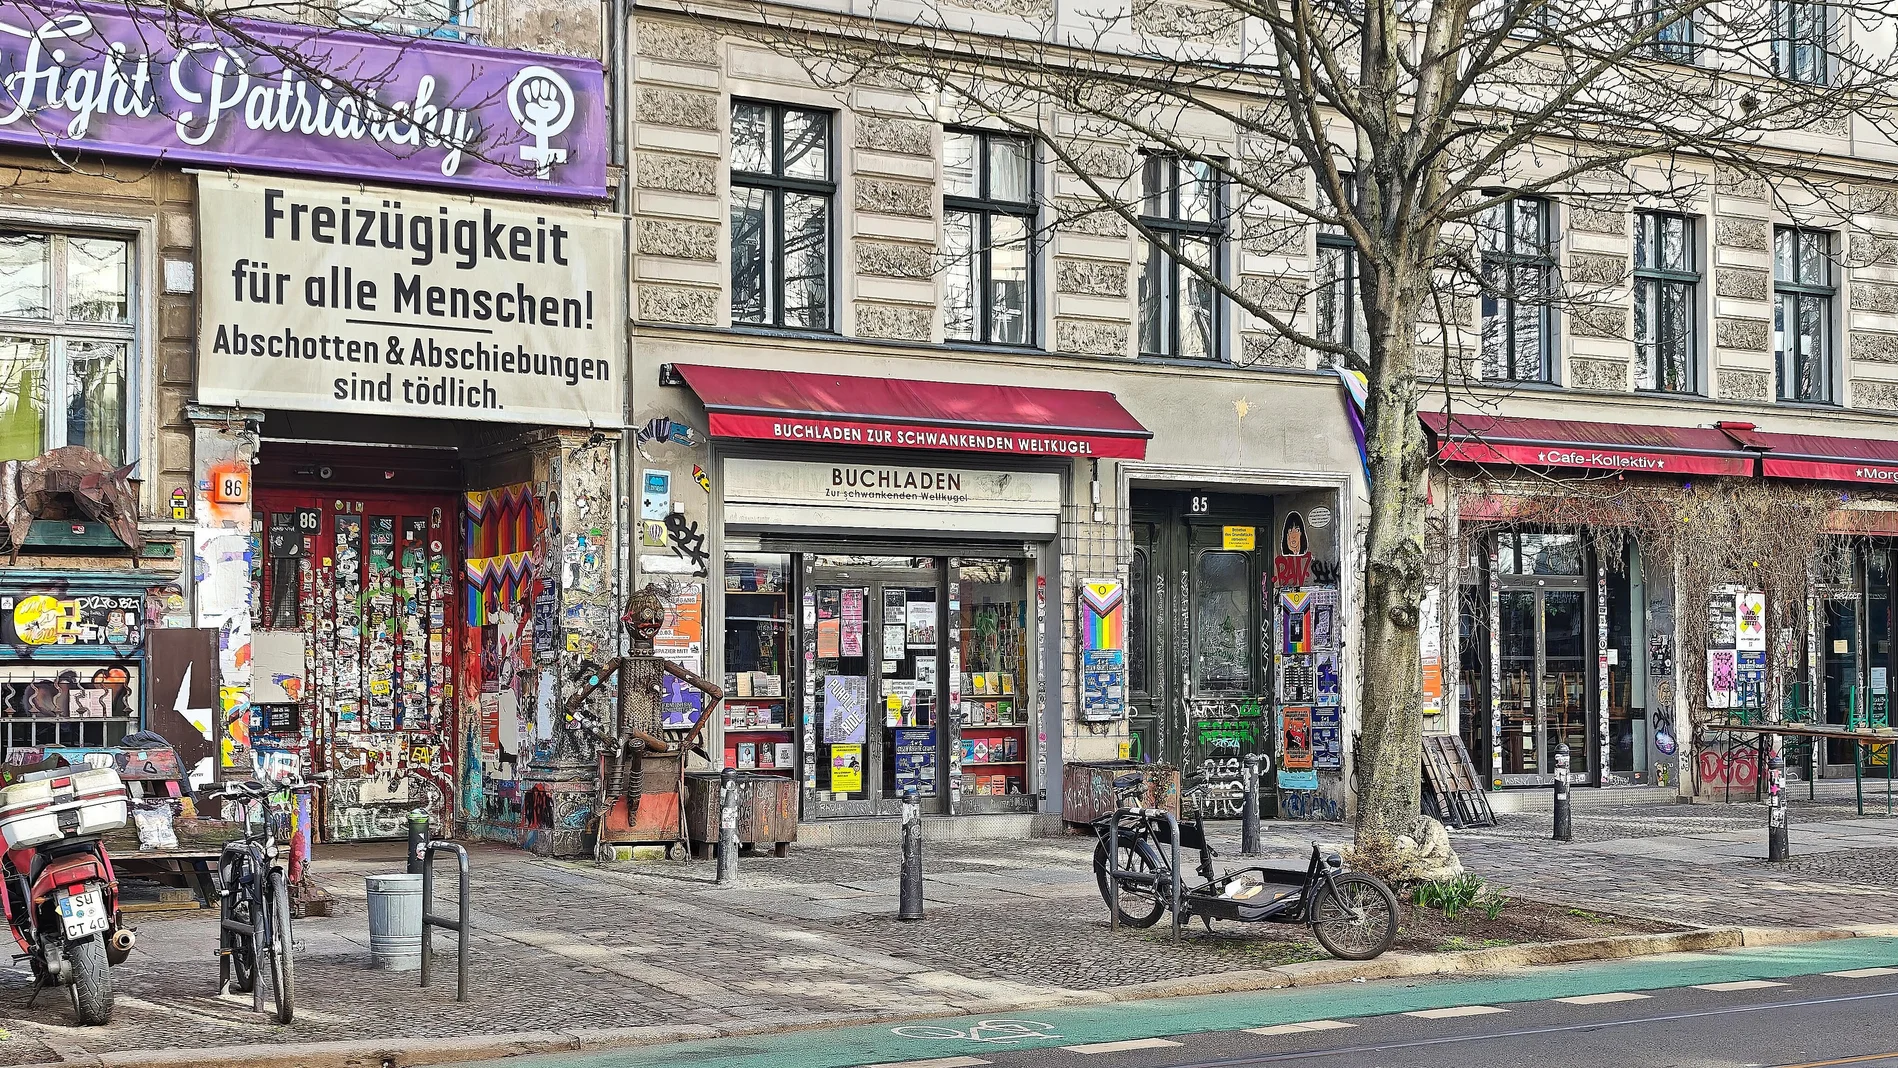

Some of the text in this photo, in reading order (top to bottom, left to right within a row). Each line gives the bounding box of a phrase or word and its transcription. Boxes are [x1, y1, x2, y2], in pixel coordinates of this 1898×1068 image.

[0, 15, 473, 177] Fight Patriarchy
[264, 189, 568, 269] Freizügigkeit
[232, 259, 593, 330] für alle Menschen!
[213, 324, 609, 386] Abschotten & Abschiebungen
[334, 372, 504, 410] sind tödlich.
[774, 423, 1092, 454] BUCHLADEN ZUR SCHWANKENDEN WELTKUGEL
[1547, 450, 1656, 468] Cafe-Kollektiv
[225, 480, 242, 496] 86
[832, 468, 961, 490] BUCHLADEN
[825, 488, 840, 497] Zur
[844, 490, 917, 500] schwankenden
[1192, 496, 1208, 511] 85
[300, 512, 317, 528] 86
[827, 678, 857, 712] PURPLE
[840, 710, 864, 736] RIDE
[75, 894, 93, 907] SU
[68, 917, 106, 937] CT 40
